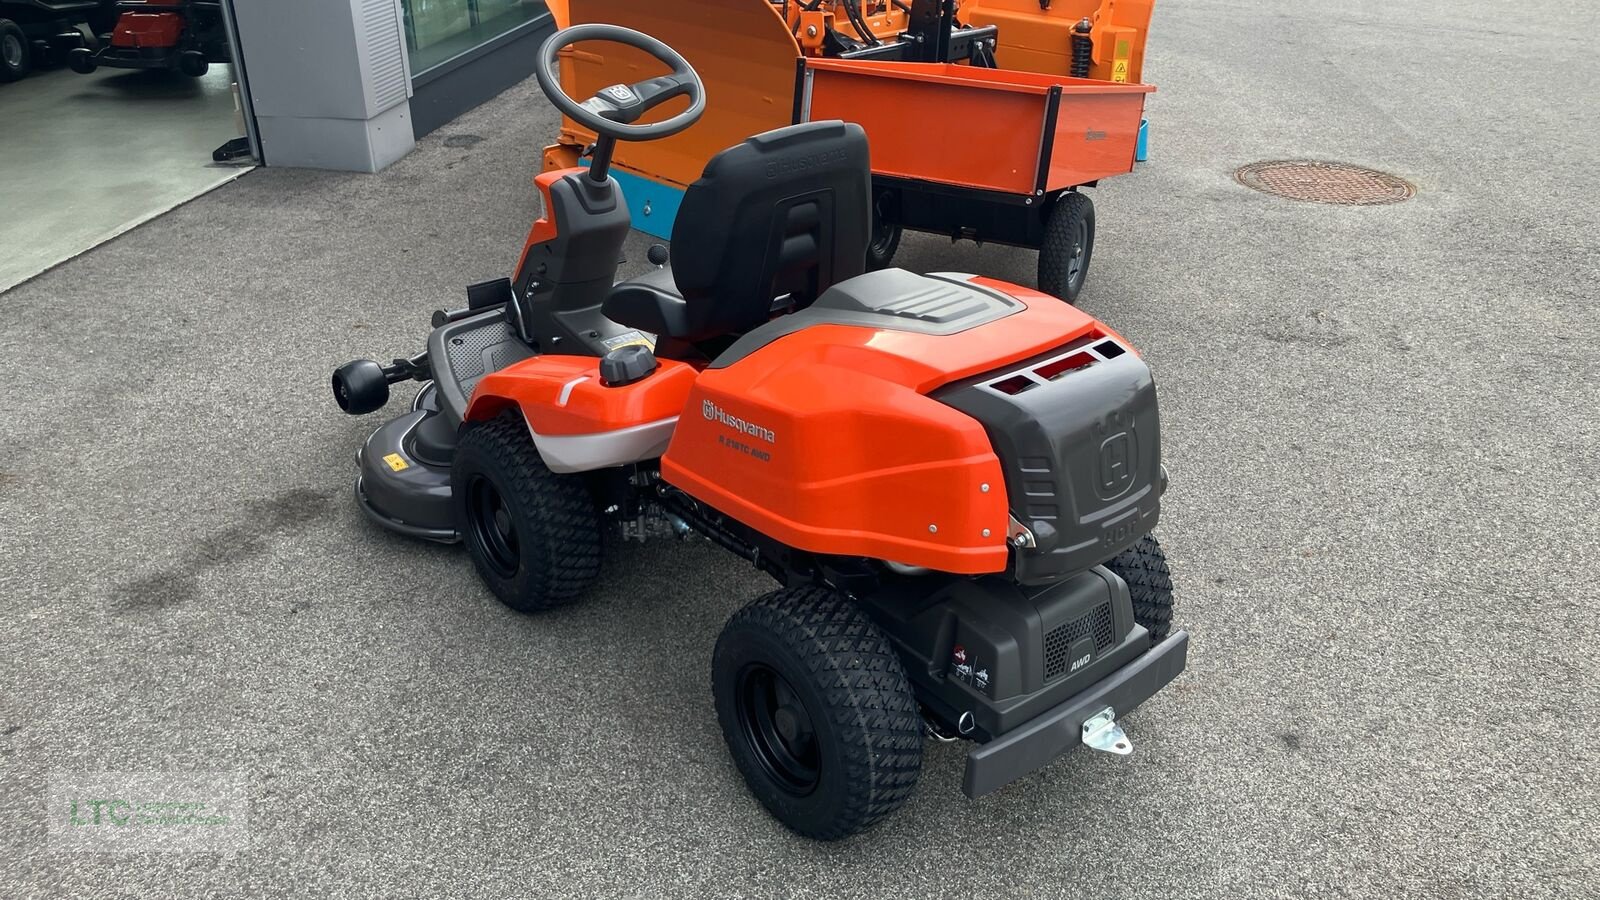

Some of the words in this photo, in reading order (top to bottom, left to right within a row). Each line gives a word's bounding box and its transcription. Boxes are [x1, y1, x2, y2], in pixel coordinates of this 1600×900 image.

[714, 405, 775, 443] Husqvarna
[751, 448, 769, 461] AWD
[1070, 653, 1091, 672] AWD
